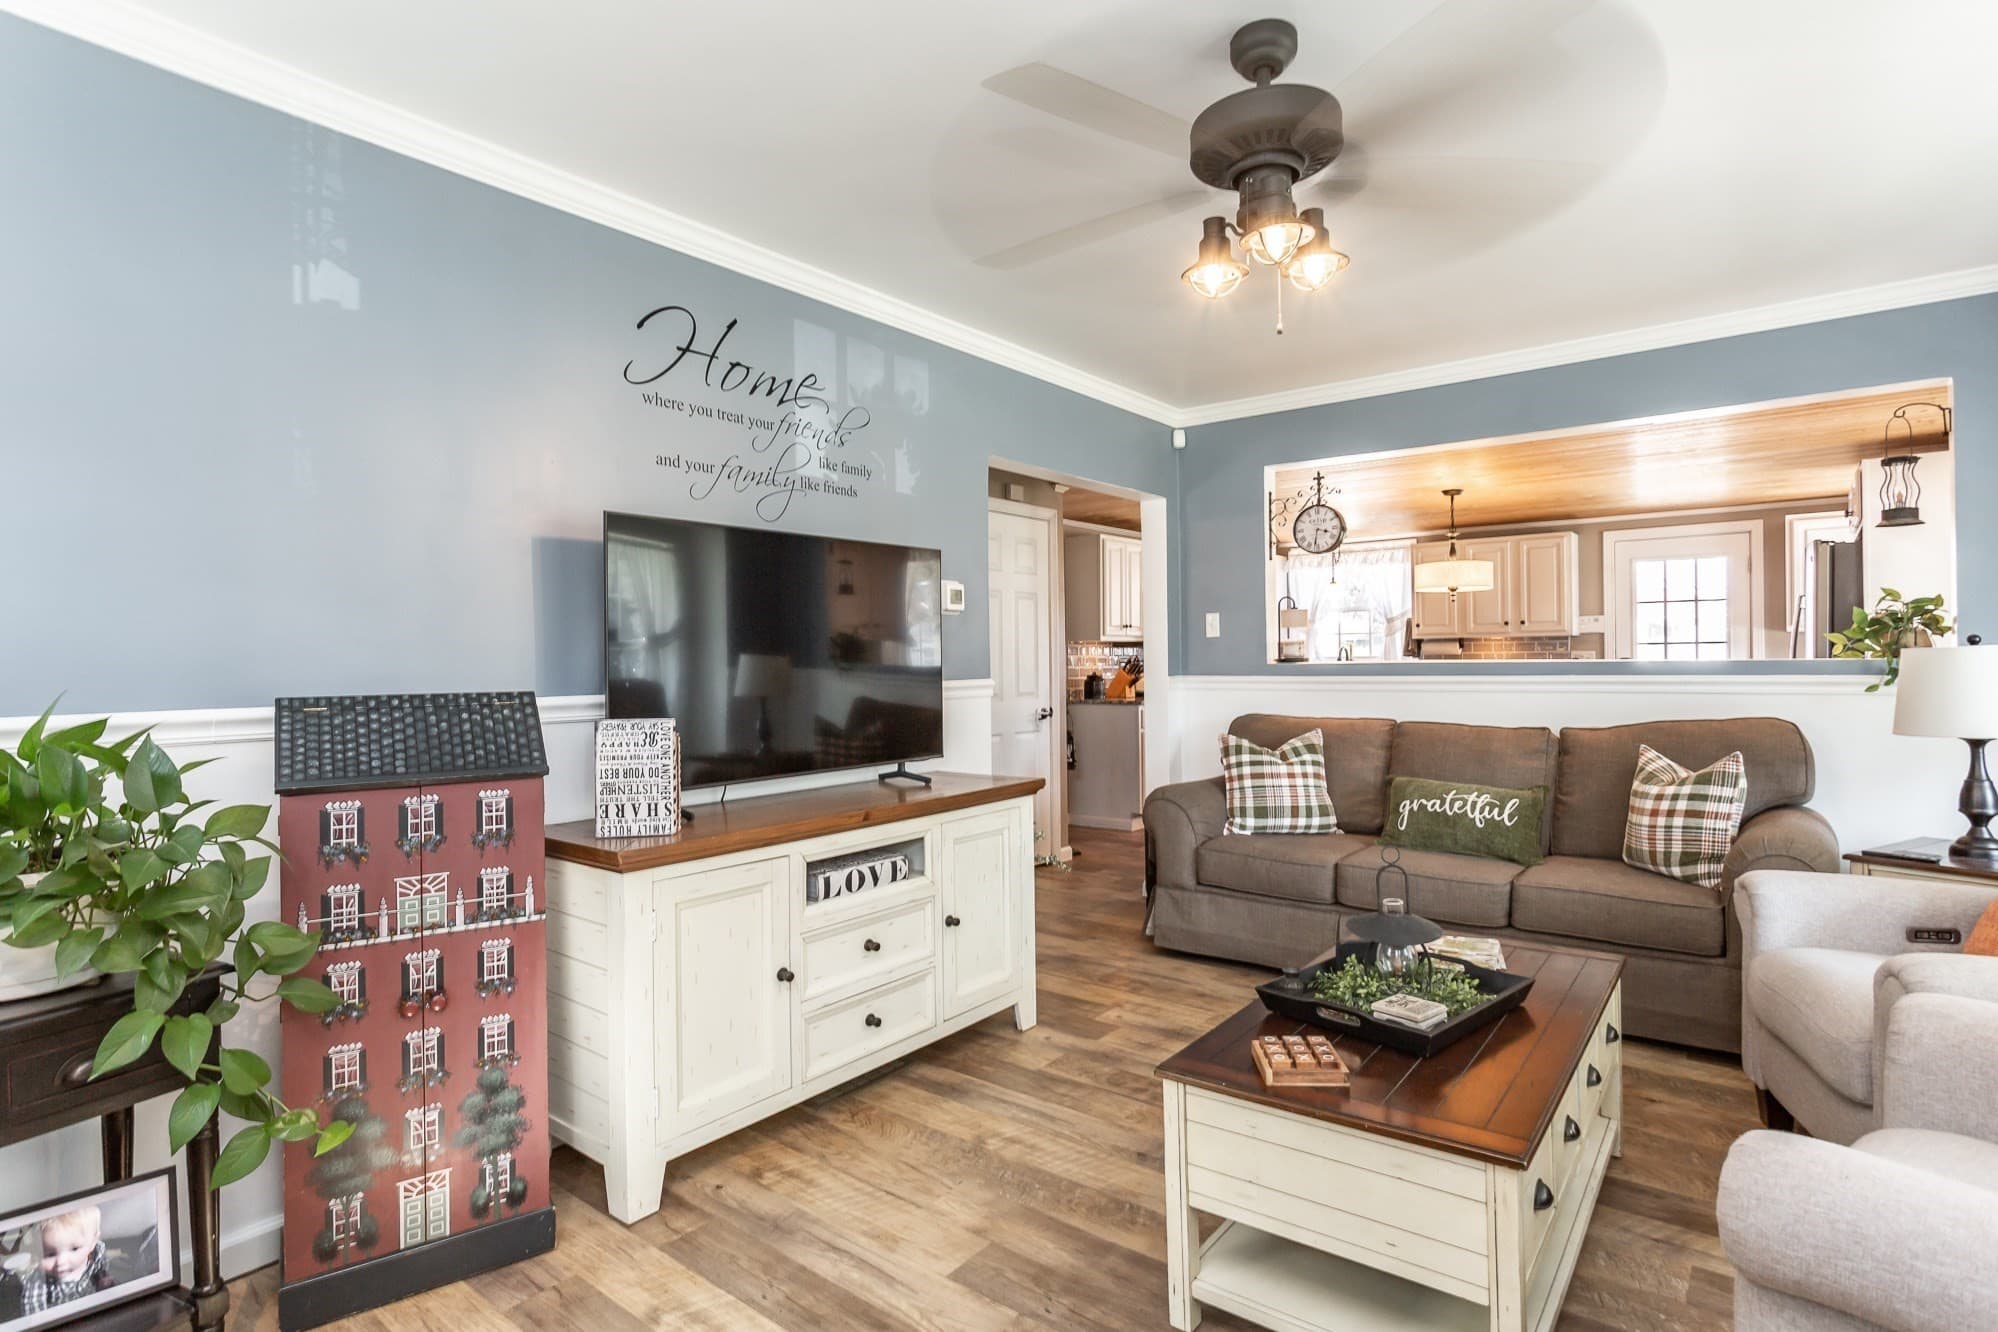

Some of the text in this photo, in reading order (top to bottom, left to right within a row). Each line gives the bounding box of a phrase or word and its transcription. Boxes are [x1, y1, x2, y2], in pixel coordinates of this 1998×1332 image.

[624, 306, 829, 415] Home
[642, 392, 871, 453] where you treat your friends
[819, 457, 873, 480] like family
[655, 442, 859, 523] and your family like friends
[600, 767, 660, 780] DO YOUR BEST
[660, 763, 671, 800] ANOTHER
[600, 786, 616, 796] HELP
[617, 784, 660, 796] LISTEN
[600, 802, 672, 819] SHARE
[600, 824, 672, 837] FAMILY RULES
[823, 857, 908, 900] LOVE
